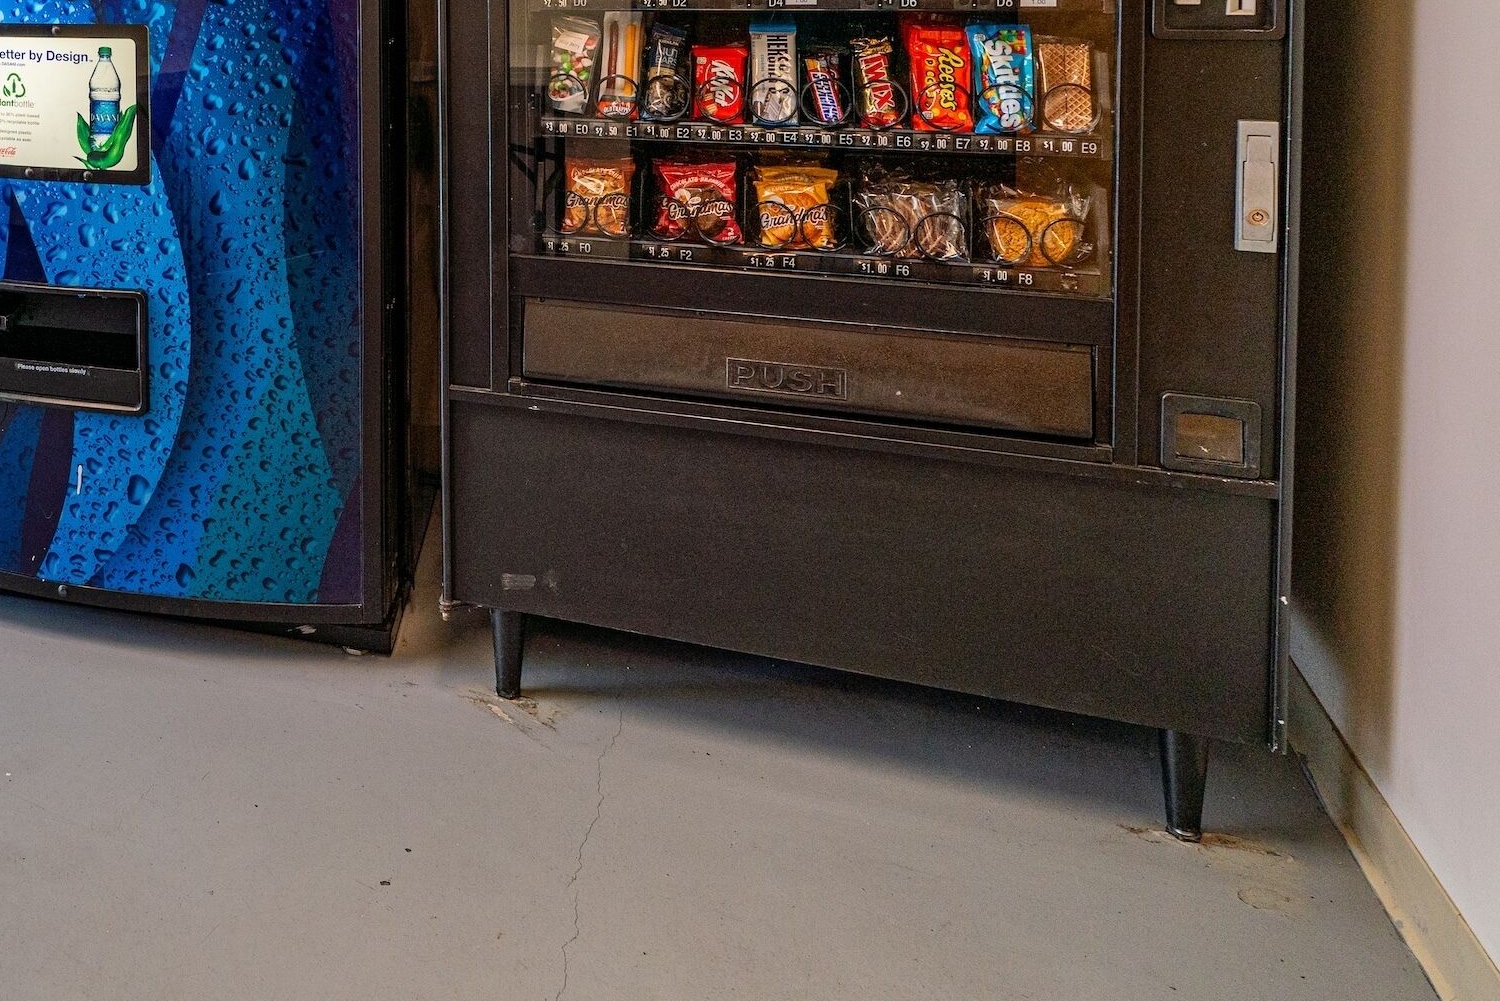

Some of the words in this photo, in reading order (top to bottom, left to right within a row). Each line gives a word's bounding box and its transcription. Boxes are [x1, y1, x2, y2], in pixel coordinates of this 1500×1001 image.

[29, 50, 43, 63] by
[860, 52, 896, 110] TWIX
[545, 121, 568, 133] $3.00
[575, 124, 588, 135] E0
[595, 126, 618, 137] $2.50
[626, 126, 638, 137] E1
[698, 129, 722, 141] $2.00
[728, 130, 743, 141] E3
[862, 135, 888, 147] $2.00
[896, 136, 911, 147] E6
[980, 139, 1008, 151] $2.00
[1015, 140, 1031, 152] E8
[1043, 141, 1073, 153] $1.00
[1081, 142, 1097, 155] E9
[579, 242, 591, 253] F0
[783, 257, 795, 268] F4
[896, 265, 910, 276] F6
[1018, 273, 1033, 285] F8
[17, 363, 35, 371] Please
[36, 365, 49, 374] open
[50, 365, 68, 374] bottles
[69, 366, 87, 376] slowly
[732, 365, 844, 396] PUSH
